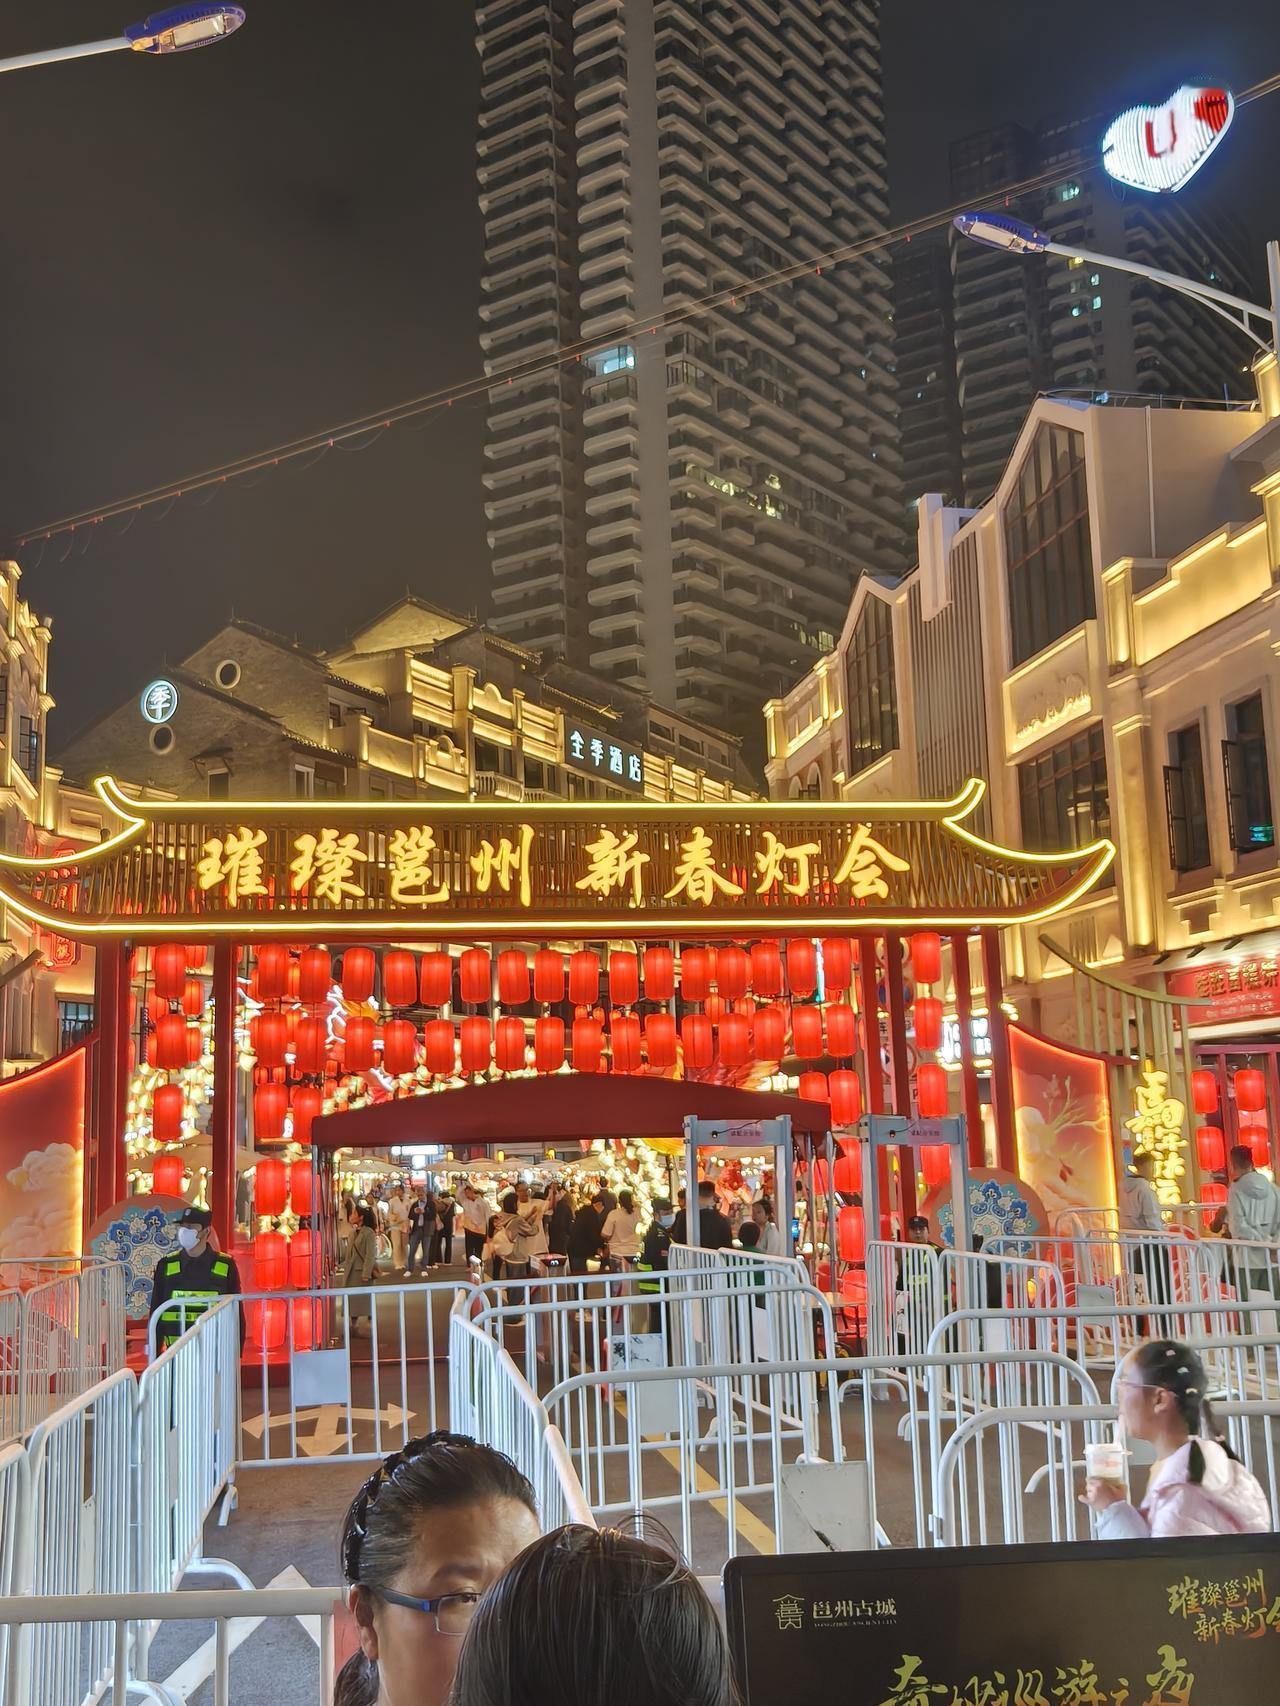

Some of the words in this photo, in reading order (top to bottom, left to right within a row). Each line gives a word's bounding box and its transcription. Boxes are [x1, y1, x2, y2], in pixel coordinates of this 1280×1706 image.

[570, 730, 642, 782] 全季酒店
[196, 824, 911, 907] 璀璨邕州新春灯会
[813, 1598, 897, 1619] 邕州古城
[1166, 1568, 1268, 1620] 璀璨邕州
